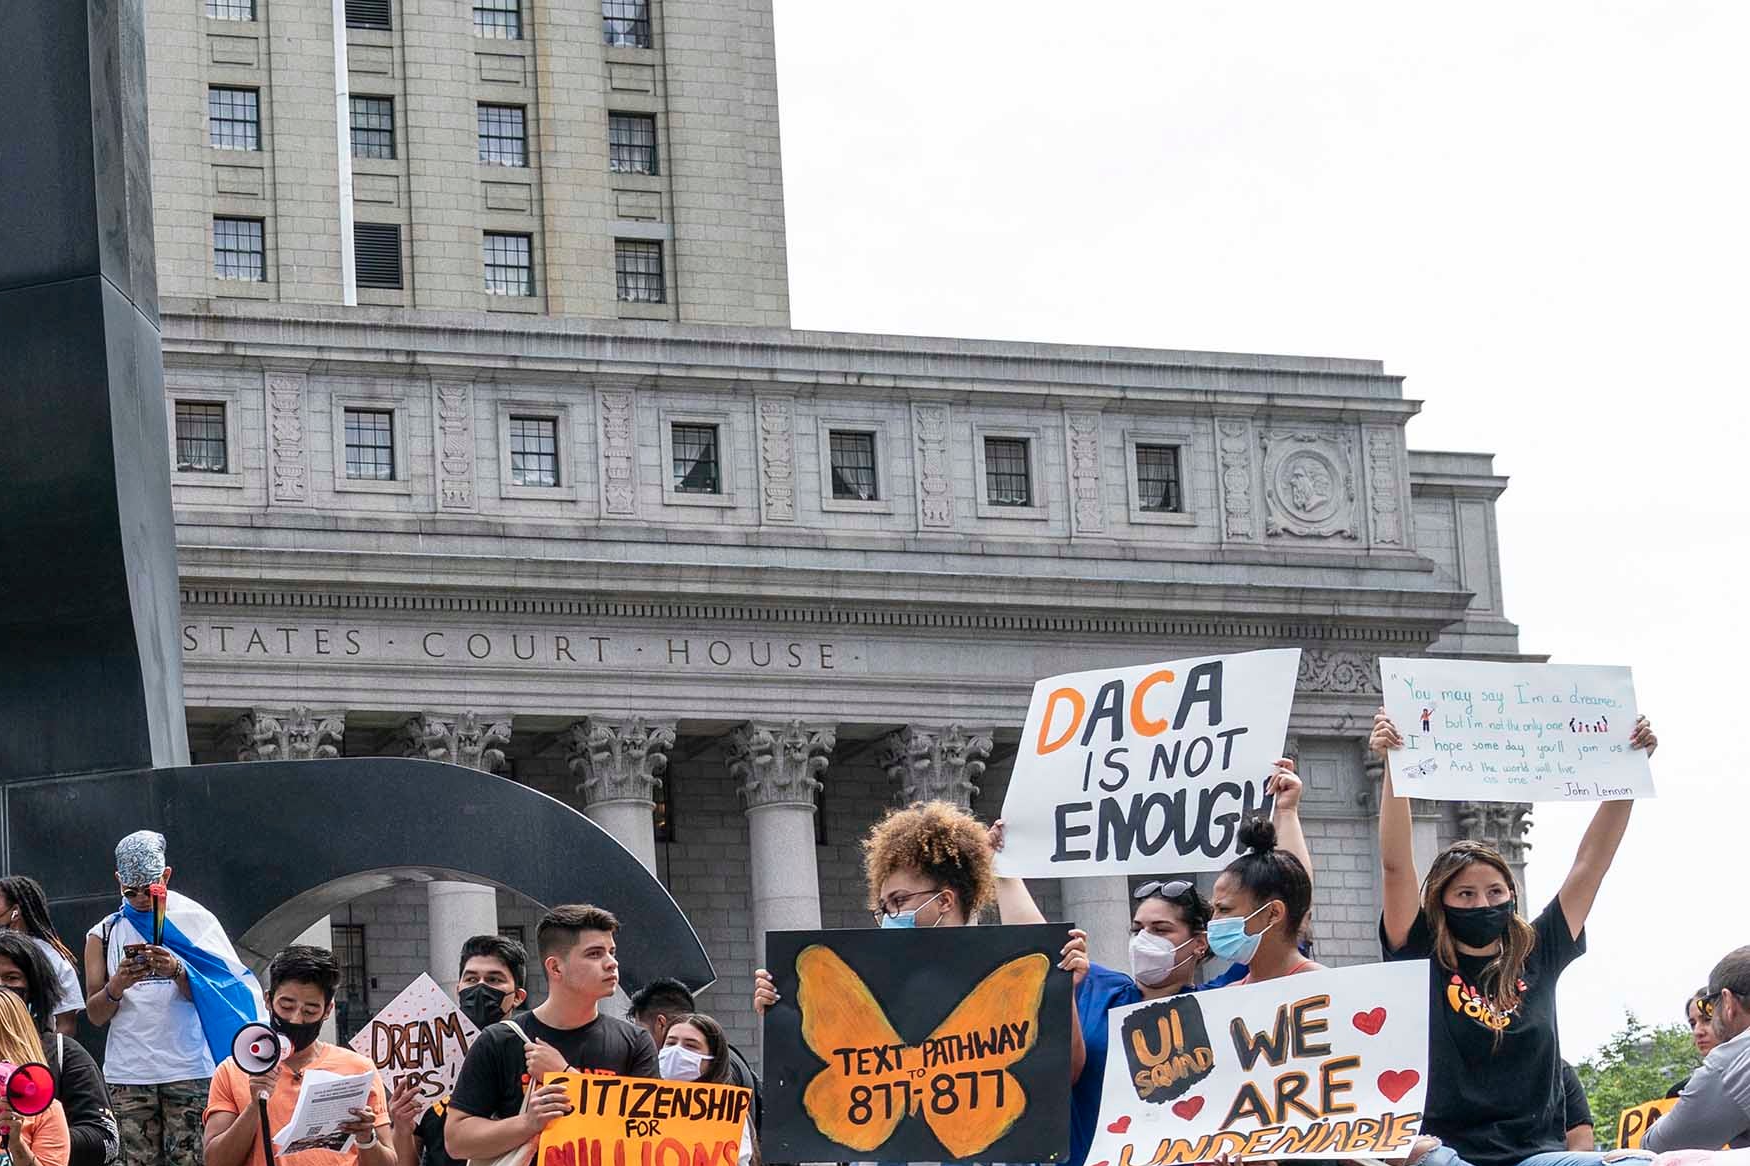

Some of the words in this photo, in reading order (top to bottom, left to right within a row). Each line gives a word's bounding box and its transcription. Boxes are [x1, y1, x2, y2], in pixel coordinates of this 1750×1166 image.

[182, 624, 362, 657] STATES
[422, 632, 611, 663] COURT
[665, 638, 835, 669] HOUSE
[1037, 660, 1223, 756] DACA
[1441, 689, 1474, 716] may
[1481, 691, 1505, 714] say
[1551, 694, 1563, 703] a
[1408, 734, 1419, 750] I
[1433, 737, 1463, 758] hope
[1473, 741, 1500, 751] some
[1505, 739, 1525, 758] day
[1578, 743, 1599, 761] join
[1609, 744, 1623, 753] us
[1444, 715, 1463, 729] but
[1489, 718, 1504, 730] not
[1523, 717, 1542, 738] only
[1545, 721, 1563, 730] one
[1082, 747, 1130, 792] IS
[1148, 727, 1248, 782] NOT
[1450, 760, 1474, 773] And
[1481, 761, 1498, 773] the
[1503, 761, 1530, 773] world
[1595, 782, 1634, 797] Lennon
[1050, 776, 1275, 862] ENOUGH
[833, 1043, 906, 1076] TEXT
[922, 1020, 1030, 1068] PATHWAY
[1230, 994, 1332, 1072] WE
[907, 1068, 926, 1080] TO
[1134, 1047, 1214, 1097] SQUAD
[1218, 1055, 1361, 1131] ARE
[847, 1069, 1004, 1126] 877-877
[625, 1119, 661, 1138] FOR
